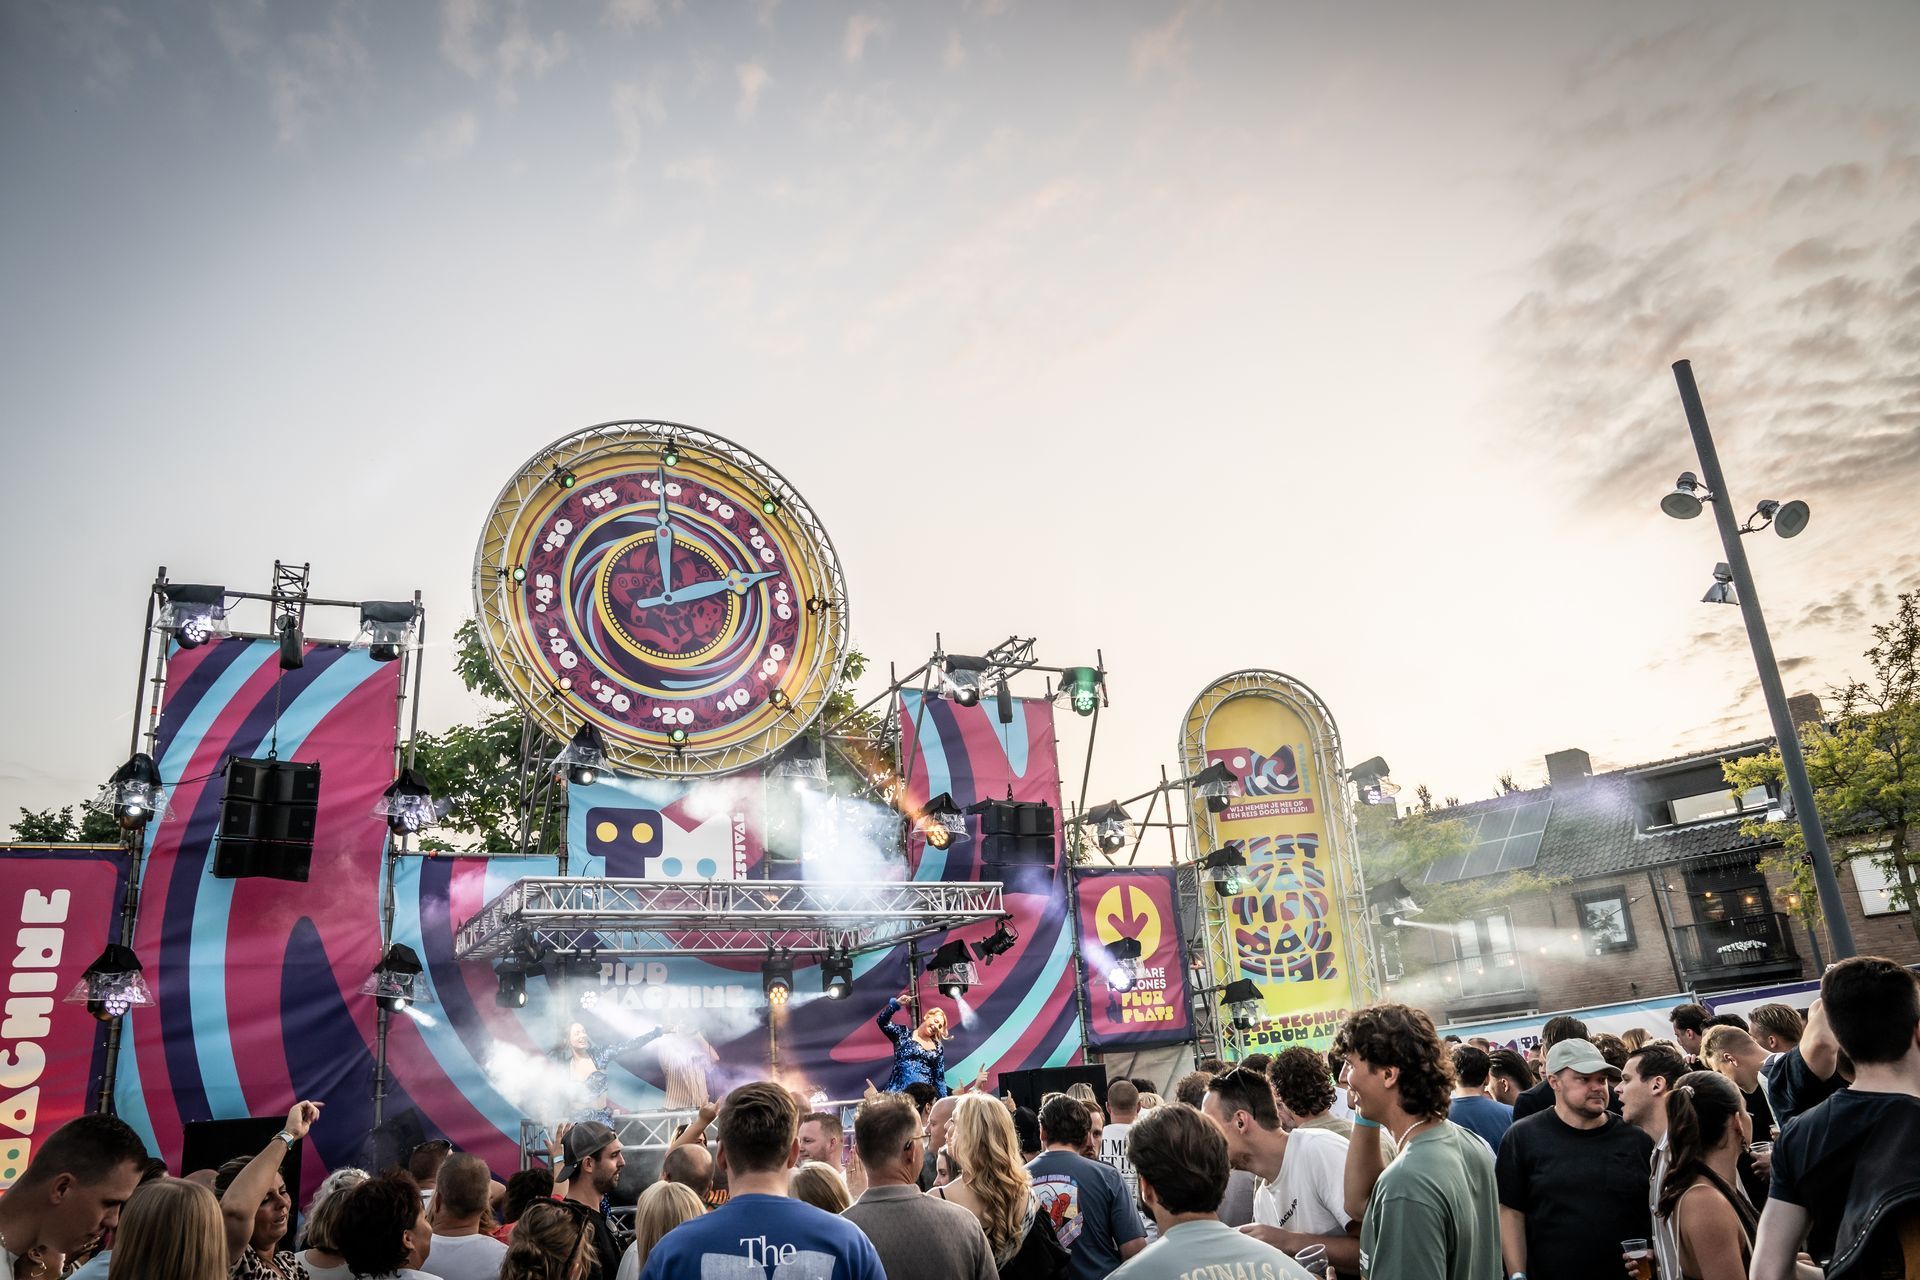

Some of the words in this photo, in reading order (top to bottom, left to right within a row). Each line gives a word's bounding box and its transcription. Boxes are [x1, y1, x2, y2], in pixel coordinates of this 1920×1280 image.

[1241, 810, 1258, 818] REIS
[1259, 808, 1280, 816] DOOR
[1232, 890, 1329, 926] TIJD
[1235, 920, 1333, 958] MAC
[739, 1235, 797, 1269] The
